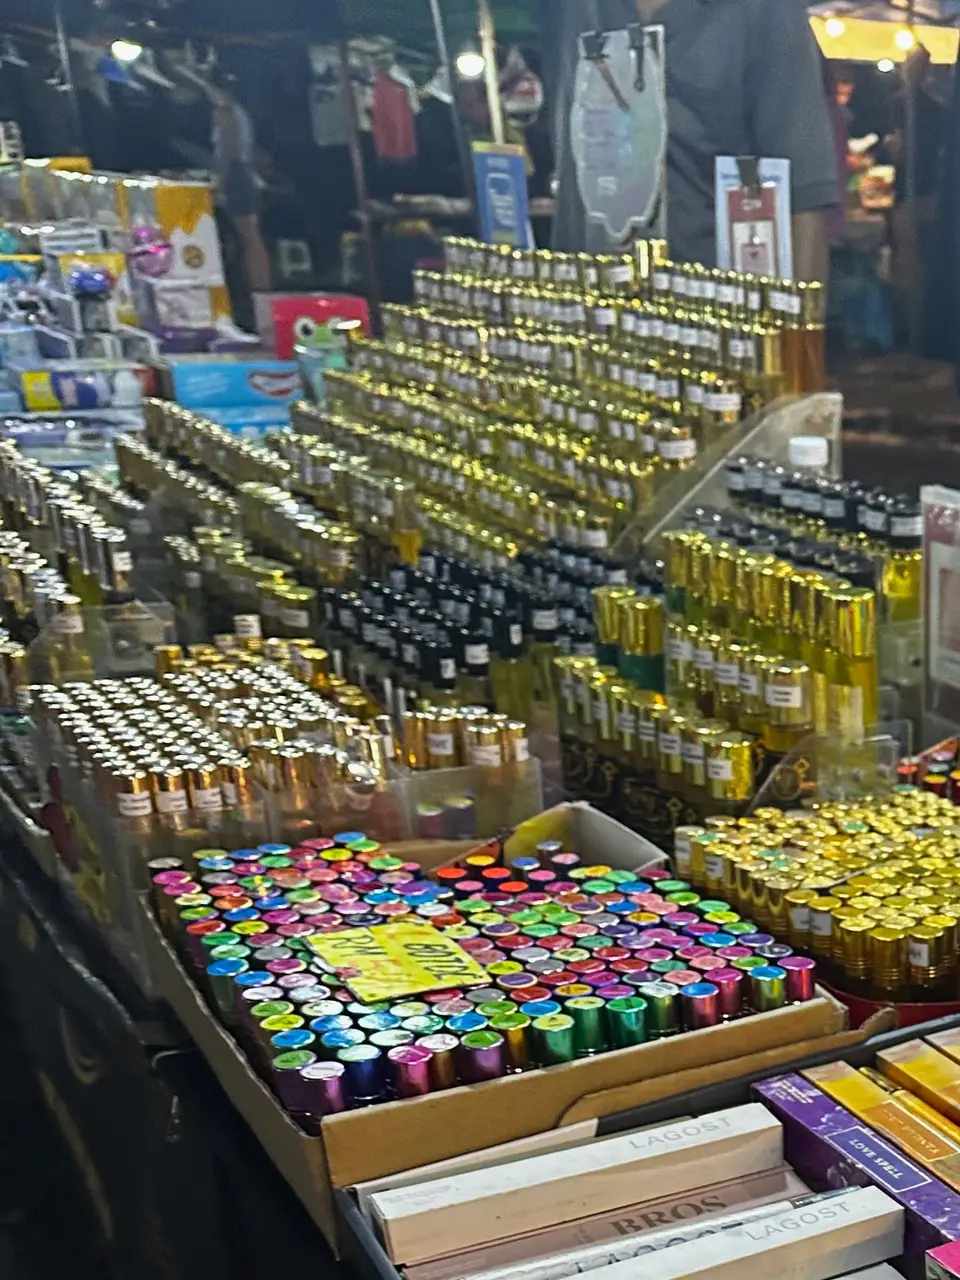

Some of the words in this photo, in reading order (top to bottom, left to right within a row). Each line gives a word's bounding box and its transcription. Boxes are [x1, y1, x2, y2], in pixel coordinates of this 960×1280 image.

[629, 1117, 732, 1150] LAGOST
[848, 1138, 876, 1160] LOVE
[874, 1156, 904, 1180] SPELL
[610, 1195, 729, 1236] BROS
[745, 1201, 851, 1241] LAGOST
